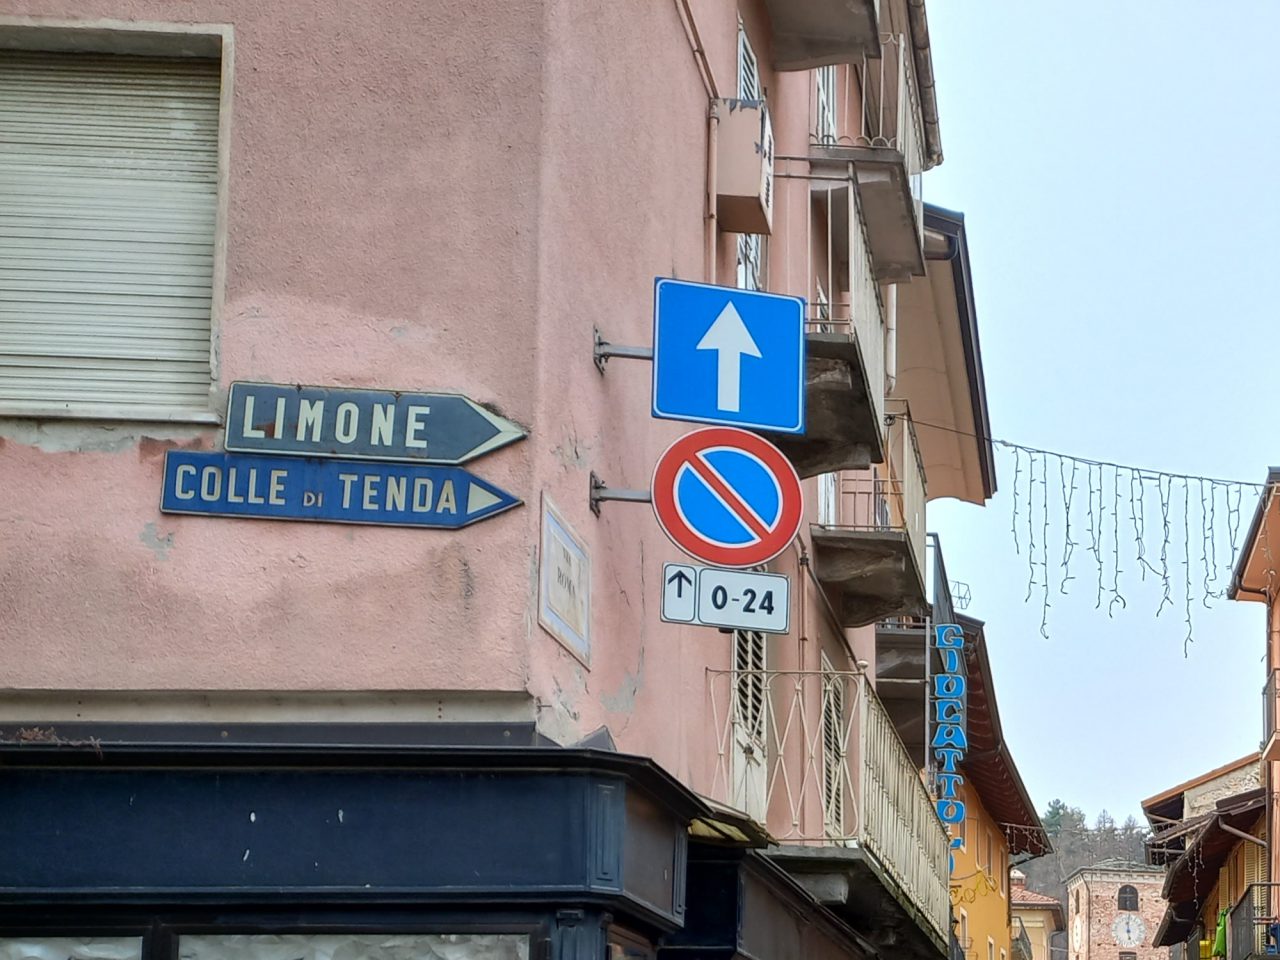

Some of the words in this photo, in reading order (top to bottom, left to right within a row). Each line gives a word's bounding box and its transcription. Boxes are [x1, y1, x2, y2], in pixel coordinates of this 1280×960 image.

[241, 394, 432, 449] LIMONE
[174, 463, 289, 505] COLLE
[339, 472, 458, 515] TENDA
[932, 623, 967, 877] GIOCATTO
